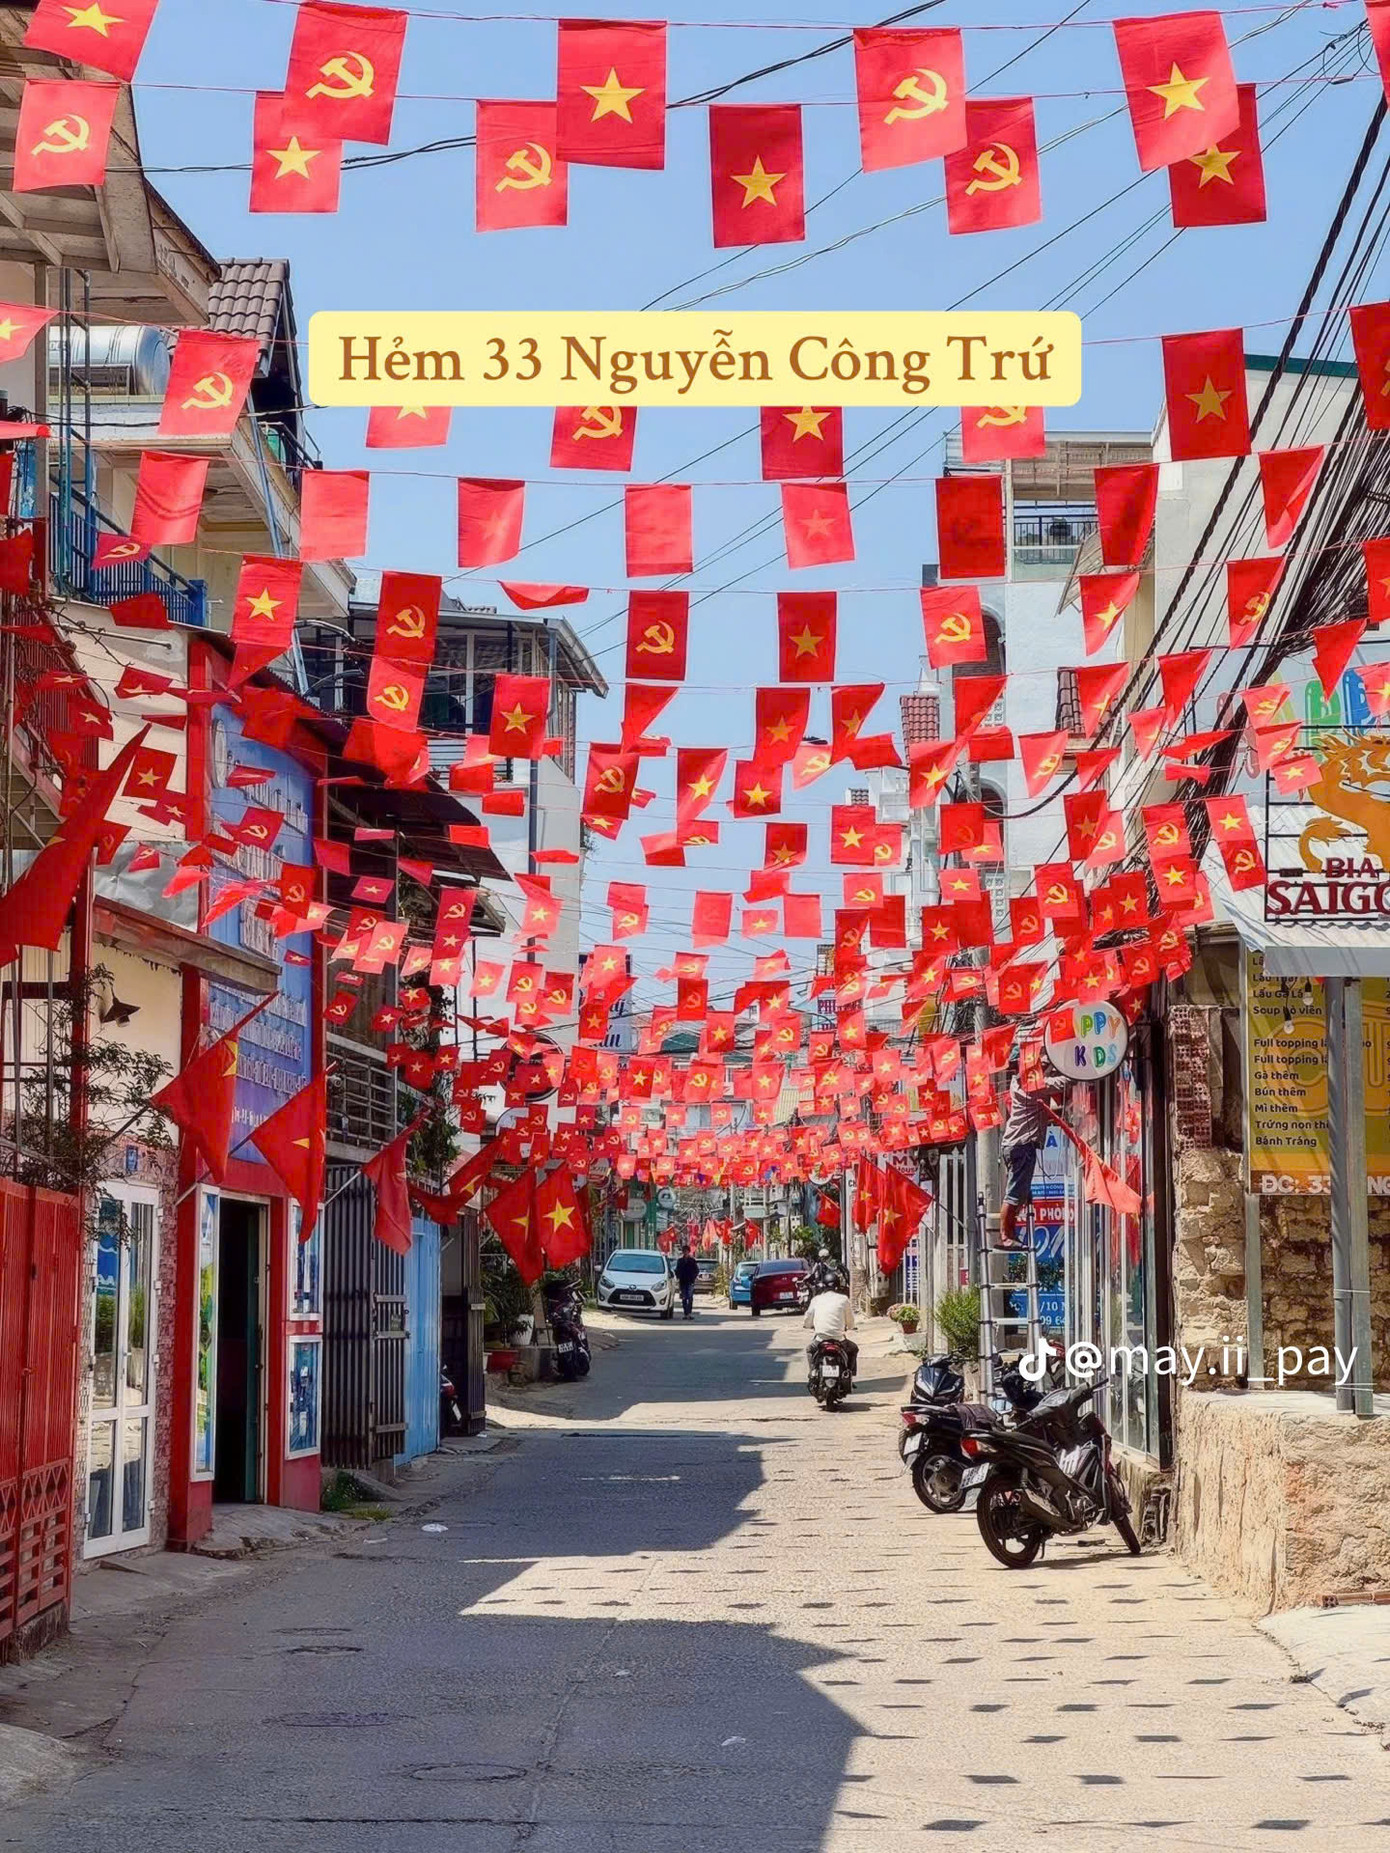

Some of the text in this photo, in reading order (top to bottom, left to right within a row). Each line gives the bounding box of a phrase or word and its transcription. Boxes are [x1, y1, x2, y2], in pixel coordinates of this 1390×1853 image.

[1325, 857, 1378, 878] BIA
[1253, 1006, 1281, 1016] Soup
[1299, 1005, 1322, 1015] viên
[1080, 1011, 1121, 1039] PPY
[1254, 1039, 1274, 1048] Full
[1276, 1039, 1319, 1049] topping
[1074, 1042, 1118, 1068] KDS
[1254, 1055, 1274, 1064] Full
[1277, 1055, 1319, 1066] topping
[1254, 1071, 1299, 1080] Gà thêm
[1255, 1087, 1306, 1096] Bún thêm
[1255, 1103, 1298, 1113] Mì thêm
[1255, 1120, 1289, 1131] Trứng
[1291, 1121, 1312, 1129] non
[1255, 1136, 1317, 1147] Bánh Tráng
[1259, 1174, 1300, 1194] ĐC:
